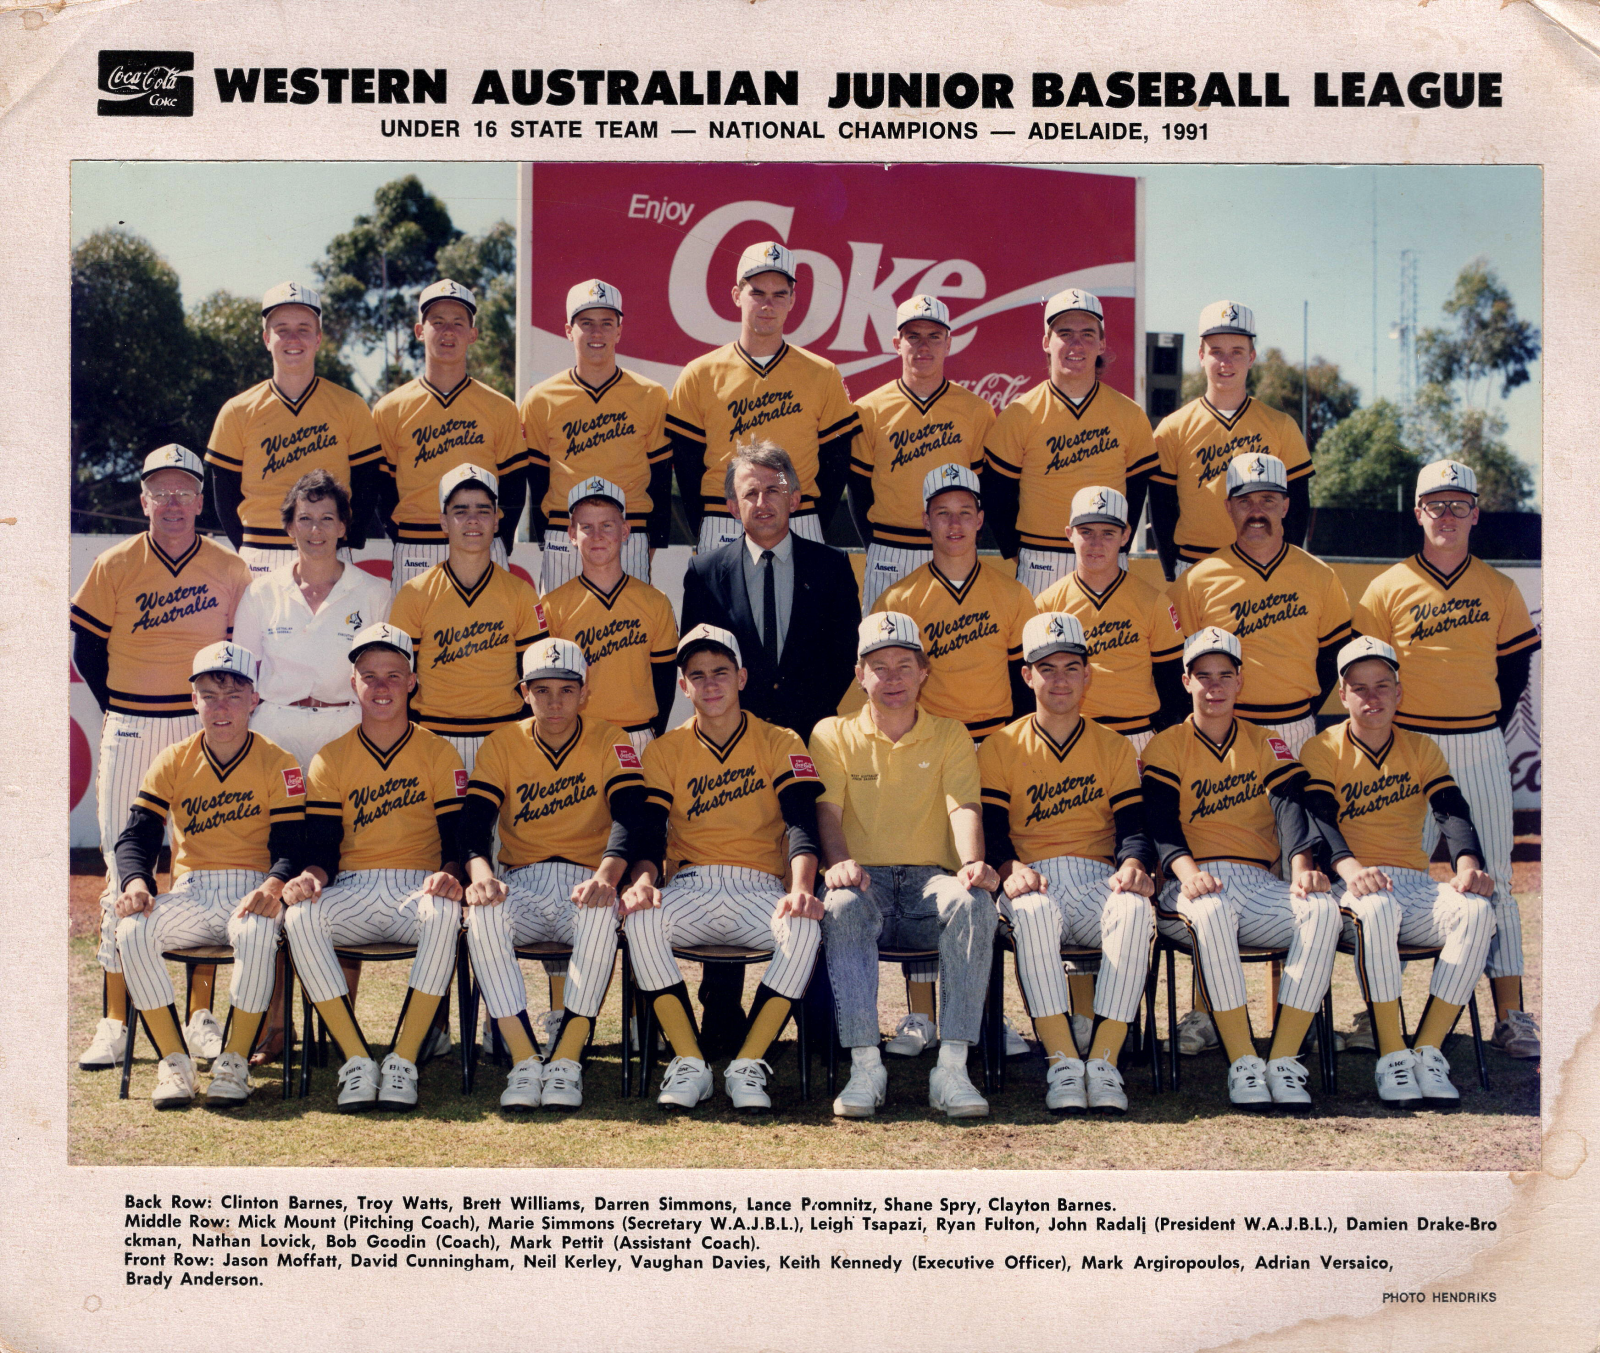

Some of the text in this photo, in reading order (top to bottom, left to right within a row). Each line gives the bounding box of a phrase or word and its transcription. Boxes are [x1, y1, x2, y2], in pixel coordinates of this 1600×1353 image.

[108, 66, 179, 91] Coca-Cola
[214, 68, 1502, 109] WESTERN AUSTRALIAN JUNIOR BASEBALL LEAGUE
[381, 120, 459, 137] UNDER
[474, 121, 497, 137] 16
[511, 120, 582, 138] STATE
[595, 121, 657, 138] TEAM
[710, 121, 825, 139] NATIONAL
[839, 122, 977, 139] CHAMPIONS
[1028, 122, 1148, 143] ADELAIDE,
[1162, 123, 1207, 140] 1991
[628, 194, 695, 225] Enjoy
[668, 200, 987, 357] Coke
[727, 390, 794, 418] Western
[261, 422, 329, 454] Western
[412, 418, 478, 447] Western
[562, 411, 628, 439] Western
[729, 402, 803, 442] Australia
[889, 421, 954, 450] Western
[413, 432, 485, 468] Australia
[564, 422, 636, 460] Australia
[890, 431, 962, 472] Australia
[1044, 436, 1120, 475] Australia
[1046, 426, 1111, 454] Western
[1196, 433, 1263, 465] Western
[262, 435, 338, 480] Australia
[719, 534, 739, 544] Anse
[135, 584, 209, 612] Western
[1230, 592, 1299, 621] Western
[1410, 597, 1482, 622] Western
[131, 595, 219, 634] Australia
[924, 610, 990, 641] Western
[1083, 619, 1132, 642] estern
[1233, 603, 1309, 638] Australia
[1409, 610, 1490, 645] Australia
[434, 620, 504, 648] Western
[575, 619, 642, 649] Western
[584, 629, 648, 666] Australia
[926, 622, 1000, 659] Australia
[1086, 630, 1140, 657] stralia
[430, 632, 509, 670] Australia
[348, 776, 420, 810] Western
[516, 772, 586, 804] Western
[687, 764, 757, 798] Western
[1026, 773, 1096, 804] Western
[1190, 768, 1257, 800] Western
[1341, 771, 1411, 803] Western
[181, 790, 254, 817] Western
[353, 788, 428, 832] Australia
[513, 783, 598, 826] Australia
[687, 775, 767, 821] Australia
[1025, 786, 1105, 827] Australia
[1190, 782, 1265, 823] Australia
[1339, 783, 1421, 823] Australia
[184, 803, 262, 837] Australia
[126, 1194, 161, 1208] Back
[172, 1195, 211, 1208] Row:
[221, 1195, 278, 1209] Clinton
[289, 1196, 347, 1212] Barnes,
[357, 1196, 392, 1213] Troy
[403, 1196, 452, 1212] Watts,
[464, 1197, 501, 1210] Brett
[511, 1196, 584, 1213] Williams,
[595, 1197, 649, 1210] Darren
[659, 1197, 736, 1213] Simmons,
[748, 1198, 791, 1211] Lance
[885, 1197, 932, 1211] Shane
[940, 1198, 981, 1215] Spry,
[989, 1197, 1049, 1215] Clayton
[1058, 1198, 1116, 1211] Barnes.
[125, 1214, 1497, 1234] Middle Row: Mick Mount (Pitching Coach), Marie Simmons (Secretary W.A.J.B.L.), Leigh Tsapazi, Ryan Fulton, John Radalj (President W.A.J.B.L.), Damien Drake-Bro
[125, 1233, 759, 1251] ckman, Nathan Lovick, Bob Goodin (Coach), Mark Pettit (Assistant Coach).
[125, 1252, 1393, 1273] Front Row: Jason Moffatt, David Cunningham, Neil Kerley, Vaughan Davies, Keith Kennedy (Executive Officer), Mark Argiropoulos, Adrian Versaico,
[127, 1271, 263, 1289] Brady Anderson.
[1383, 1292, 1496, 1303] PHOTO HENDRIKS
